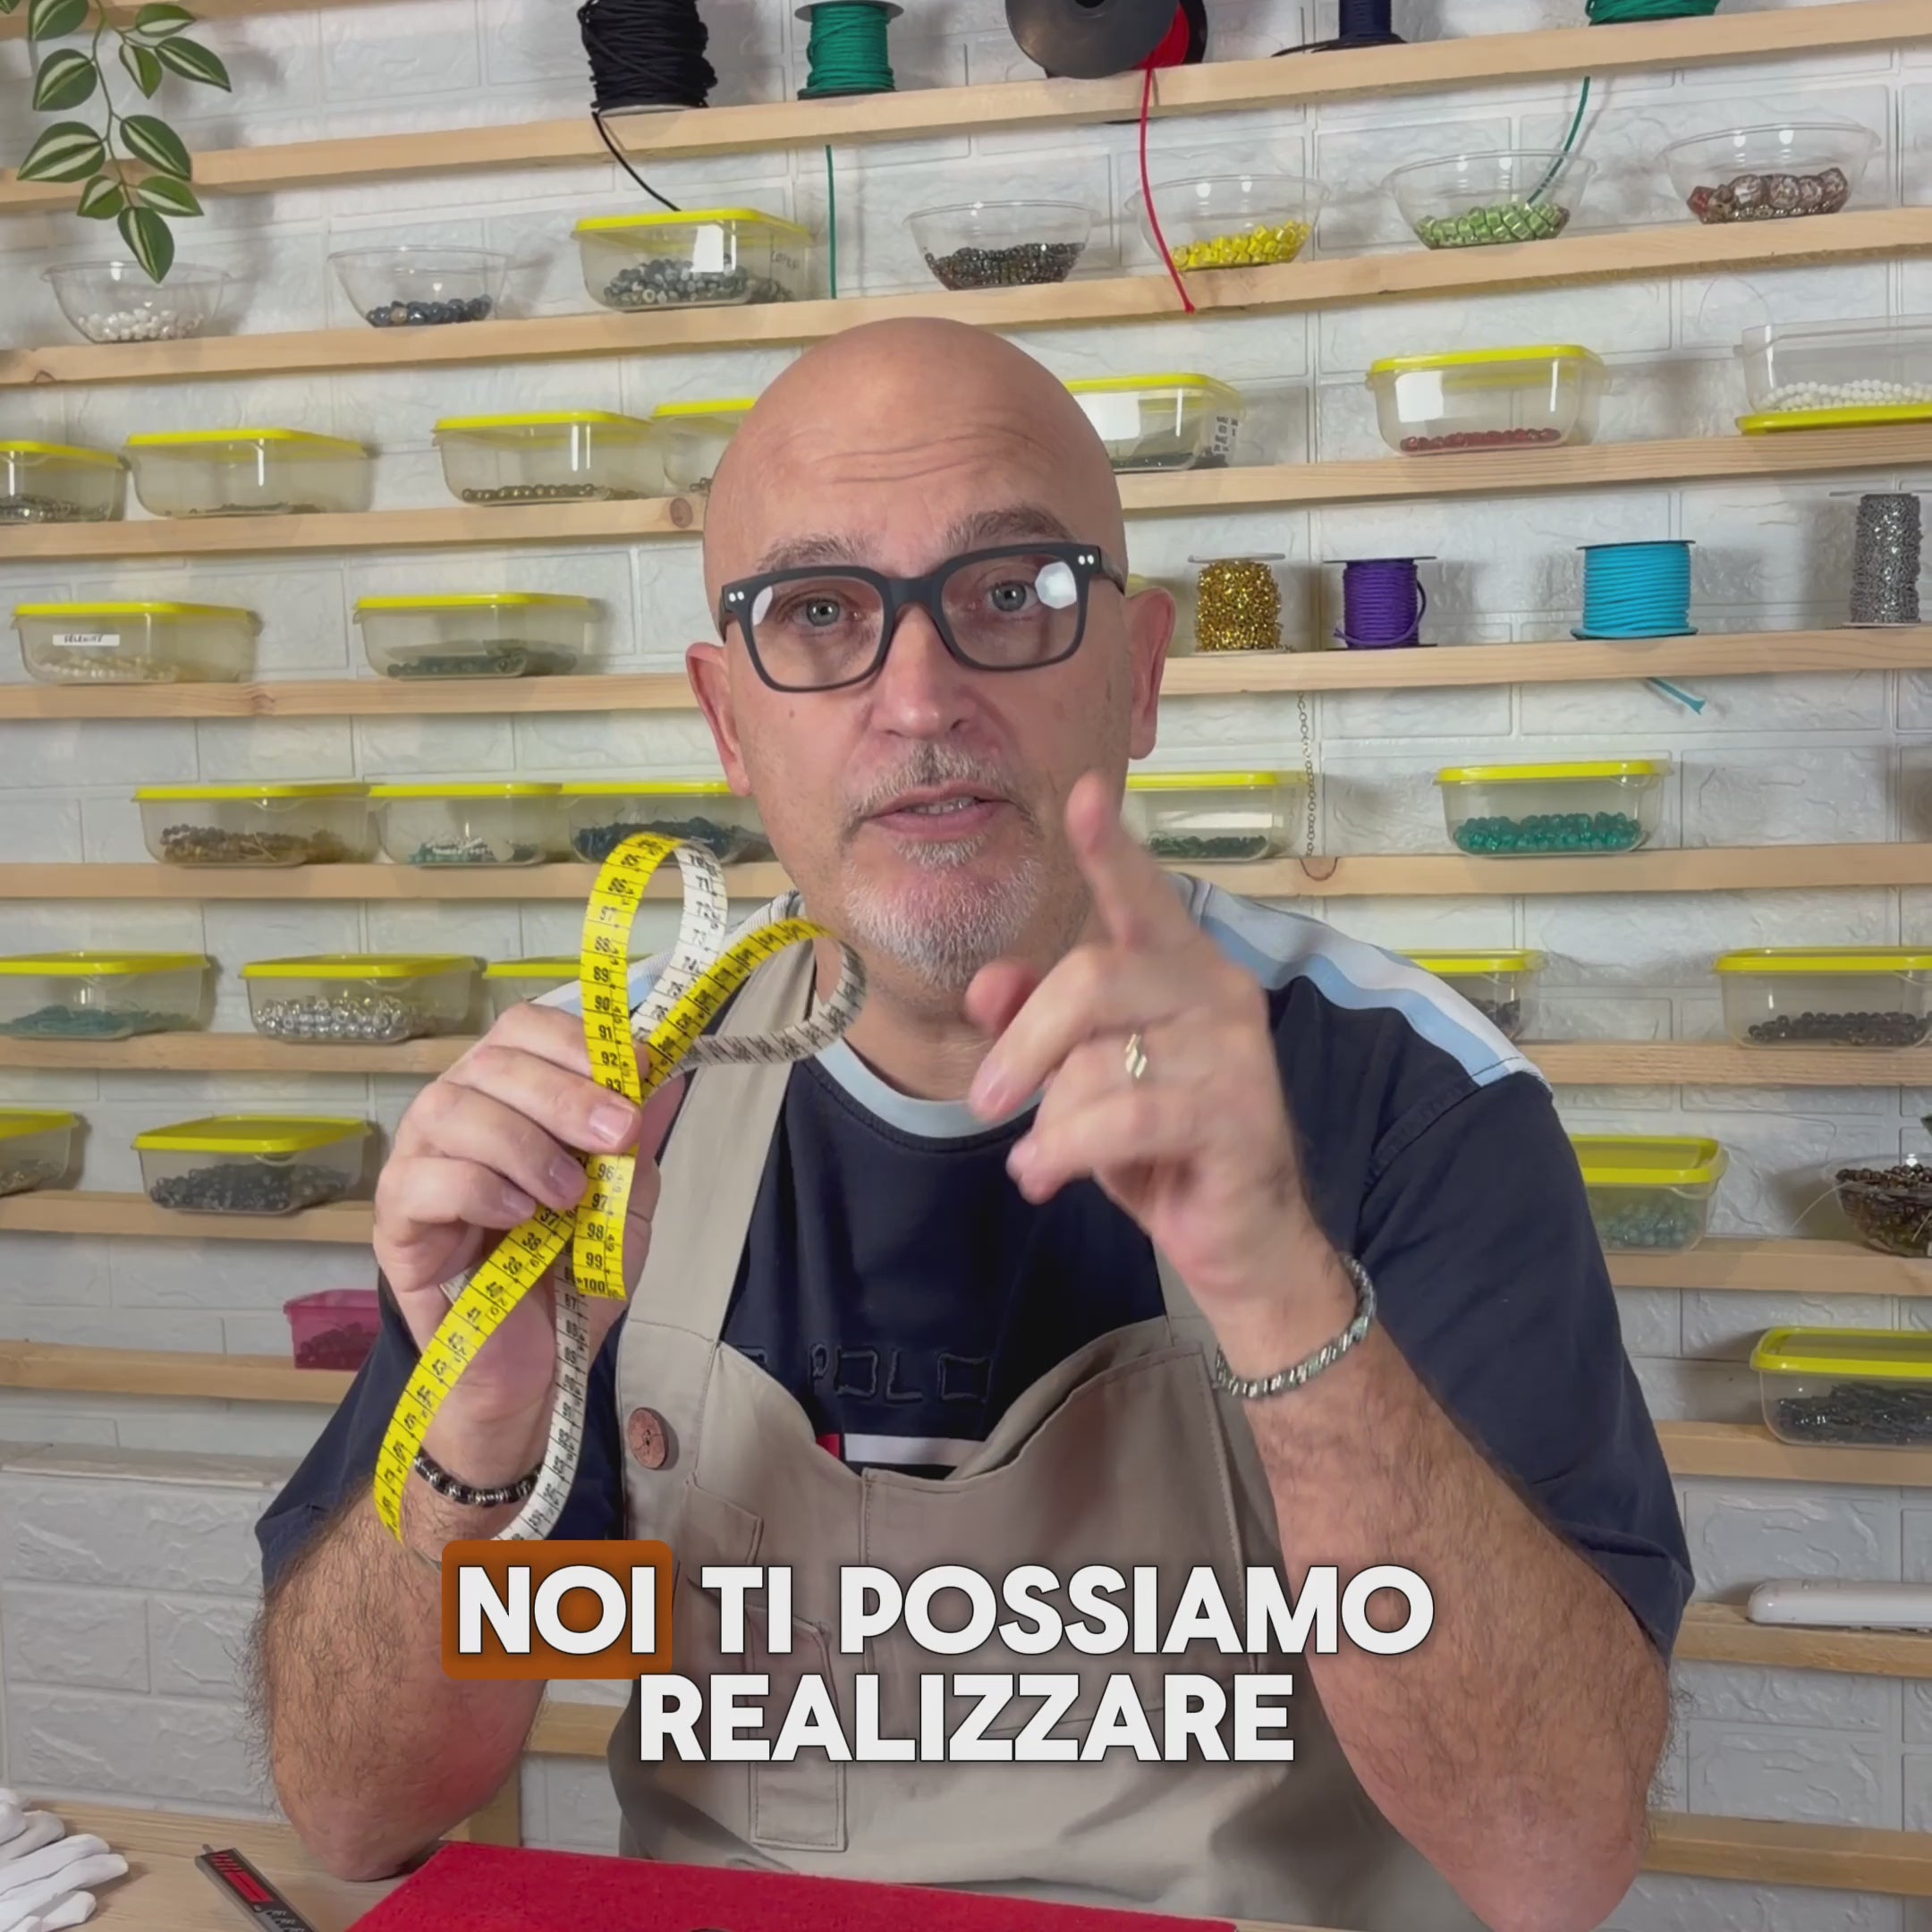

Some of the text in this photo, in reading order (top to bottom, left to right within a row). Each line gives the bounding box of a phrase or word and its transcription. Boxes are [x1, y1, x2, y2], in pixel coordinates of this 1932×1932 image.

[593, 966, 610, 983] 89
[594, 995, 611, 1011] 90
[597, 1024, 614, 1040] 91
[601, 1051, 618, 1066] 92
[597, 1163, 614, 1180] 96
[592, 1192, 609, 1209] 97
[540, 1207, 560, 1227] 37
[587, 1223, 605, 1241] 98
[521, 1232, 542, 1251] 38
[586, 1251, 603, 1268] 99
[583, 1277, 606, 1294] 100
